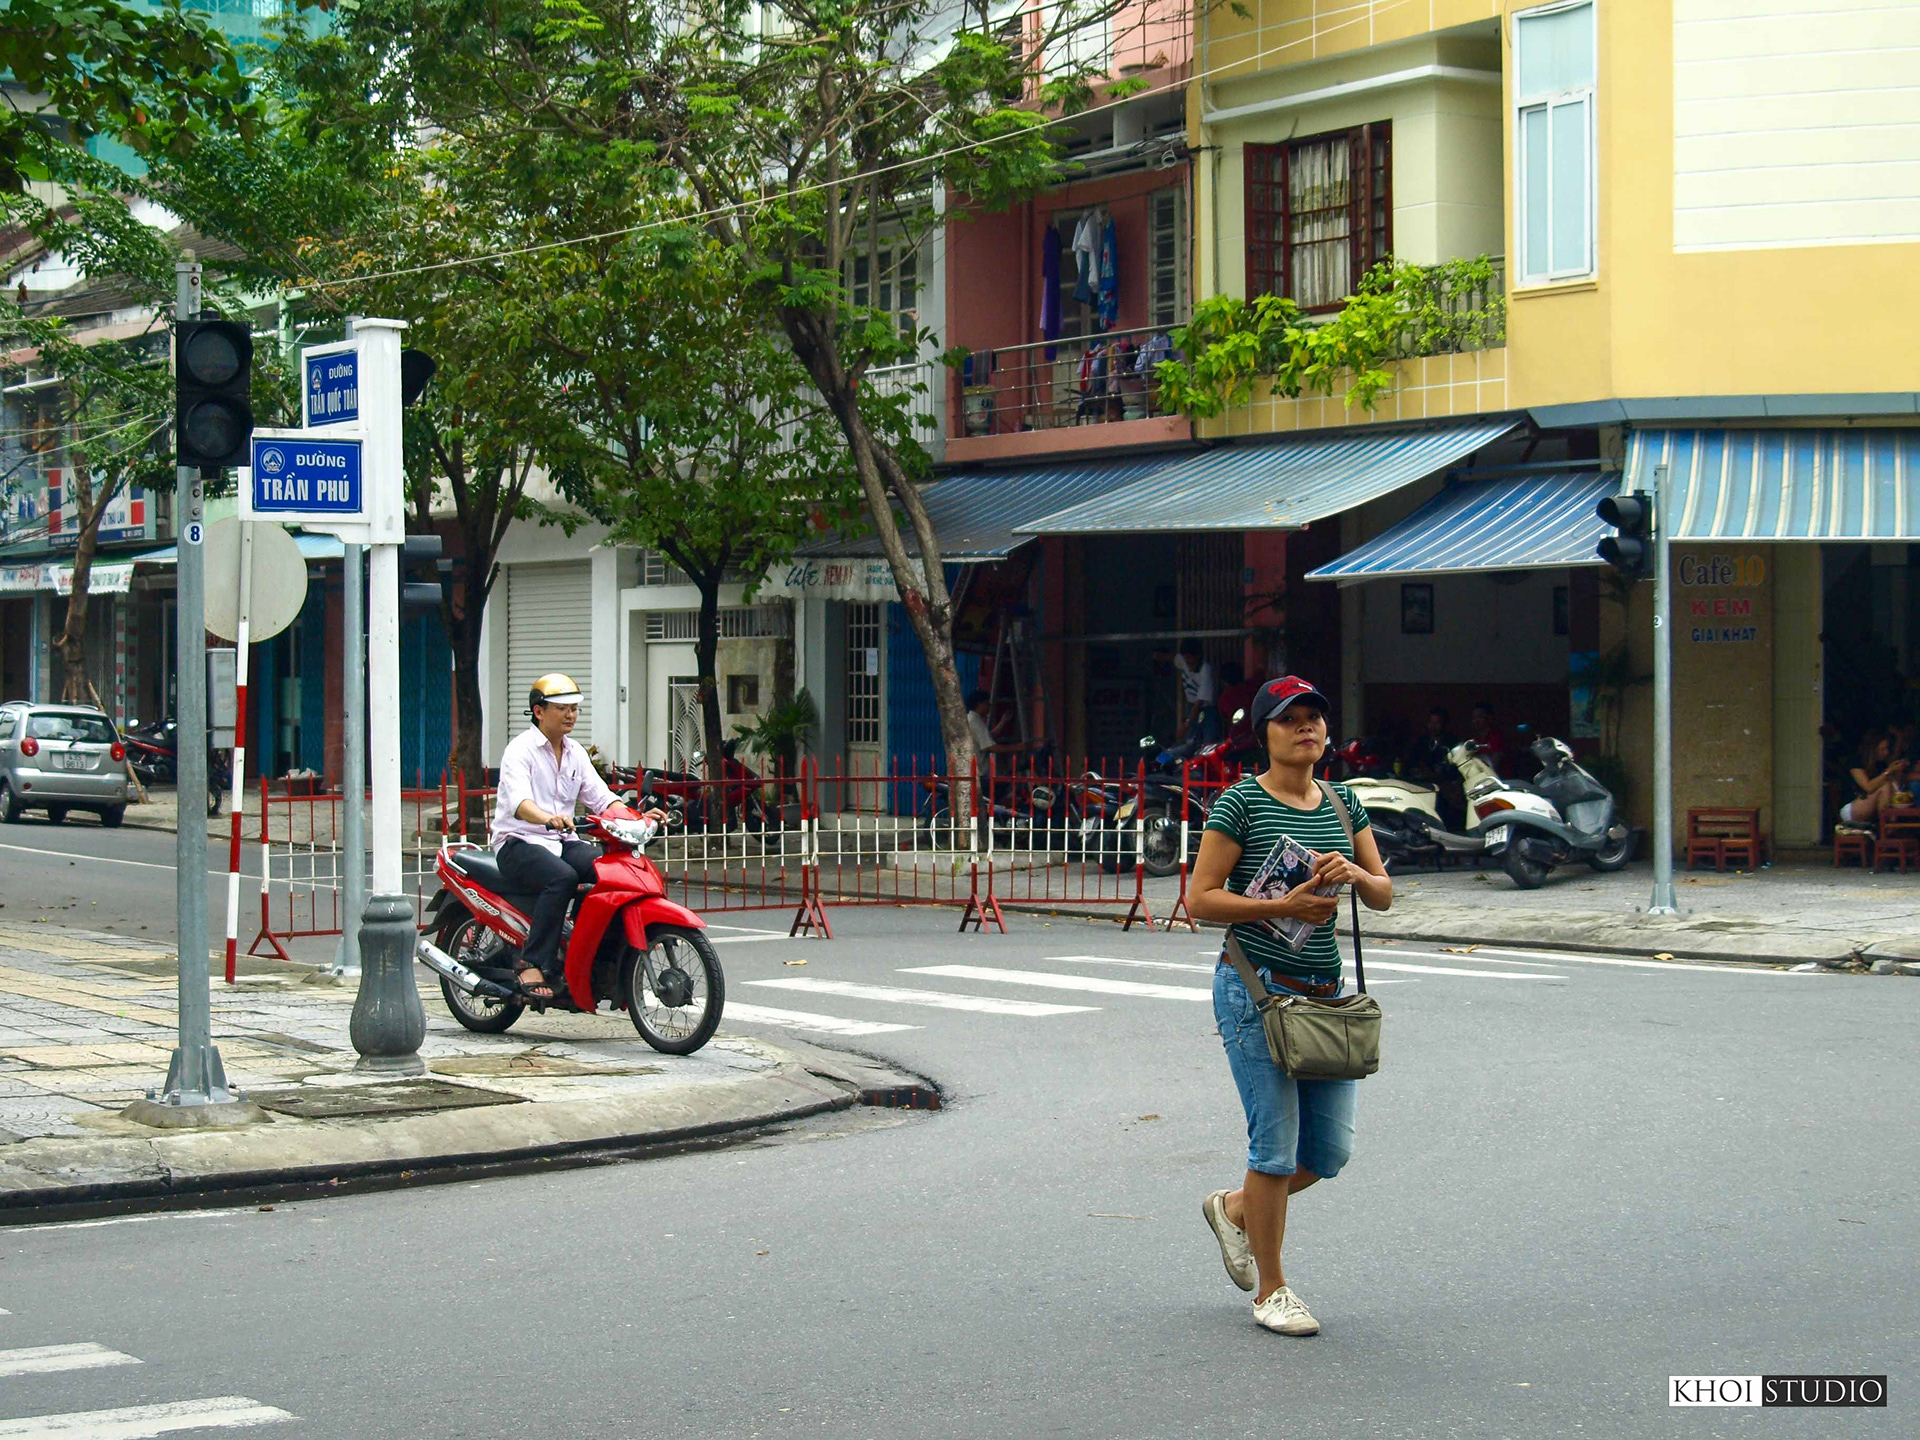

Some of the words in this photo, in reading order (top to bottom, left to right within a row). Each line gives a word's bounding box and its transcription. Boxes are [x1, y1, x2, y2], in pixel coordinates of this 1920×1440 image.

[328, 363, 353, 379] ĐƯỜNG
[296, 450, 346, 468] ĐƯỜNG
[261, 472, 309, 501] TRẦN
[317, 474, 350, 502] PHÚ
[190, 525, 200, 542] 8
[1679, 555, 1733, 586] Café
[1735, 555, 1765, 586] 10
[1691, 599, 1752, 617] KEM
